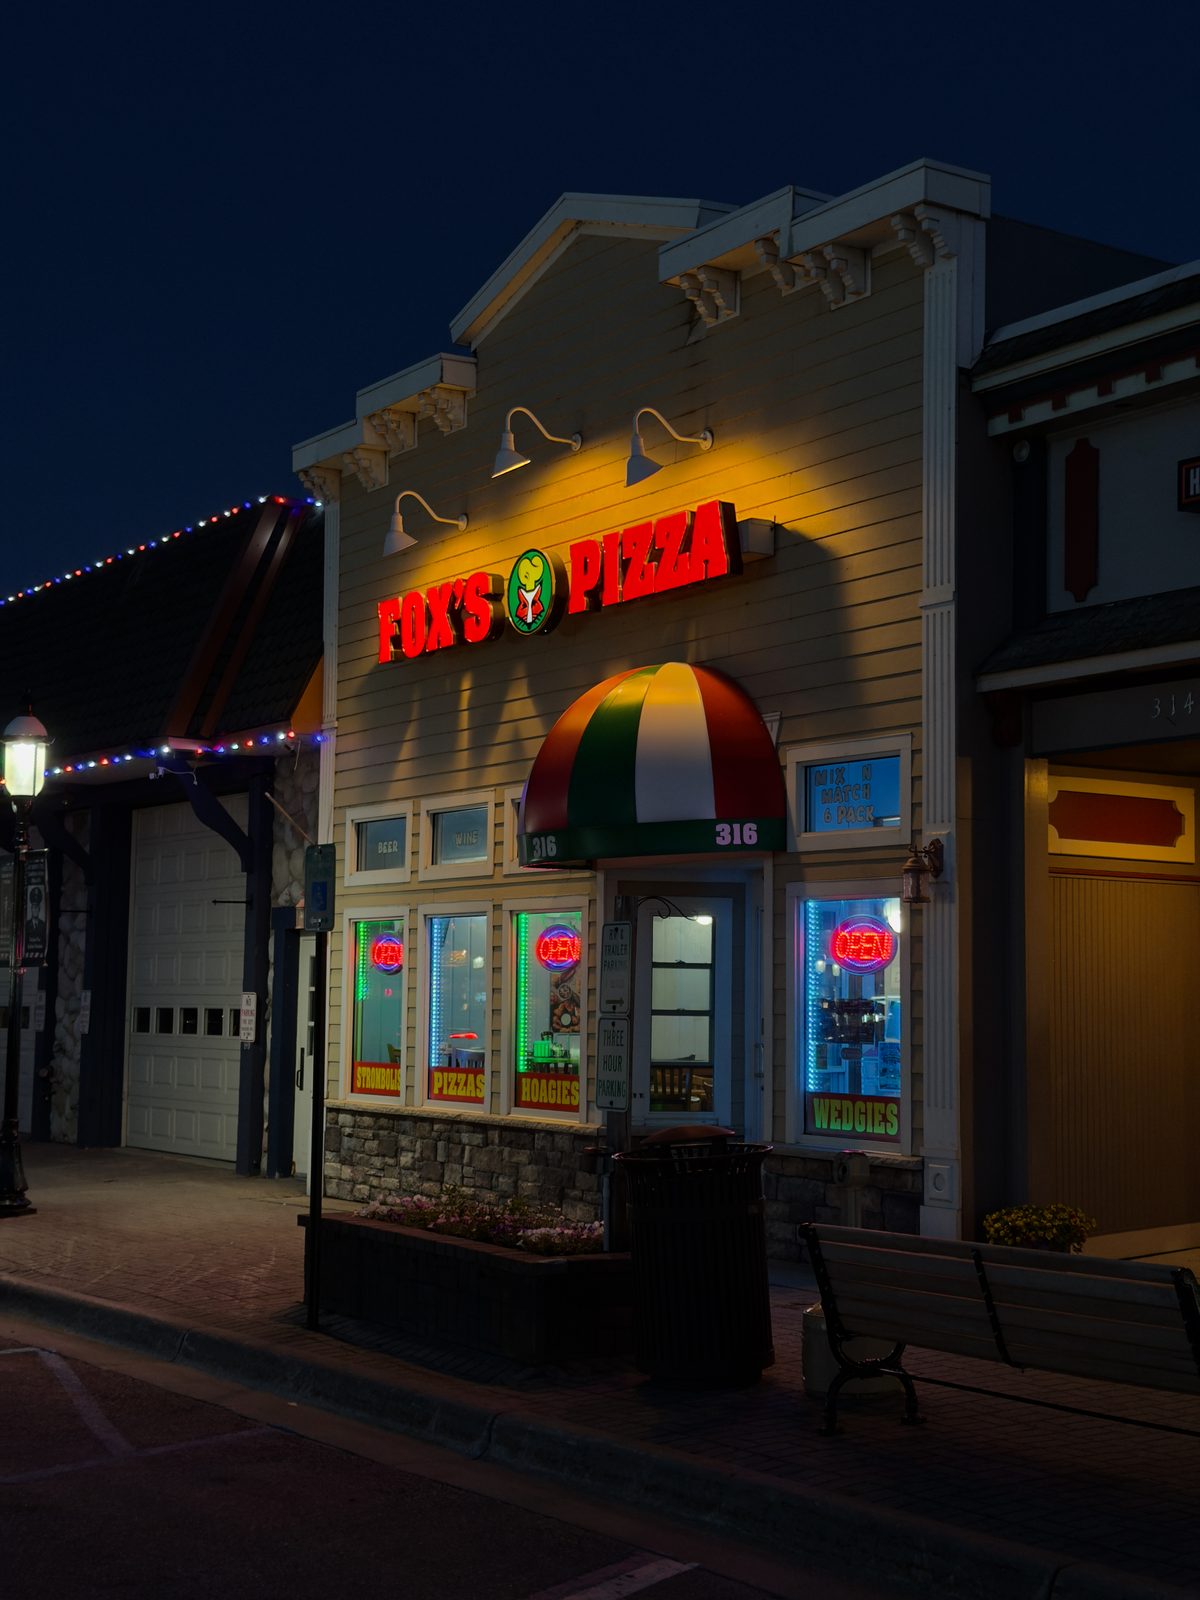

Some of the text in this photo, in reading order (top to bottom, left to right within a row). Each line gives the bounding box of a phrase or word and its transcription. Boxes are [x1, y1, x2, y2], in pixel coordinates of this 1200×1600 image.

[377, 500, 733, 664] FOX'S PIZZA
[1151, 692, 1195, 719] 314
[815, 766, 846, 786] MIX
[820, 782, 871, 804] MATCH
[824, 804, 875, 824] 6 PACK
[455, 830, 479, 846] WINE
[715, 823, 758, 846] 316
[378, 839, 399, 854] BEER
[532, 835, 558, 858] 316
[835, 931, 893, 960] OPEN
[603, 1029, 624, 1047] THREE
[603, 1055, 623, 1073] HOUR
[433, 1072, 485, 1098] PIZZAS
[521, 1077, 579, 1105] HOAGIES
[599, 1079, 626, 1099] PARKING
[813, 1097, 898, 1136] WEDGIES
